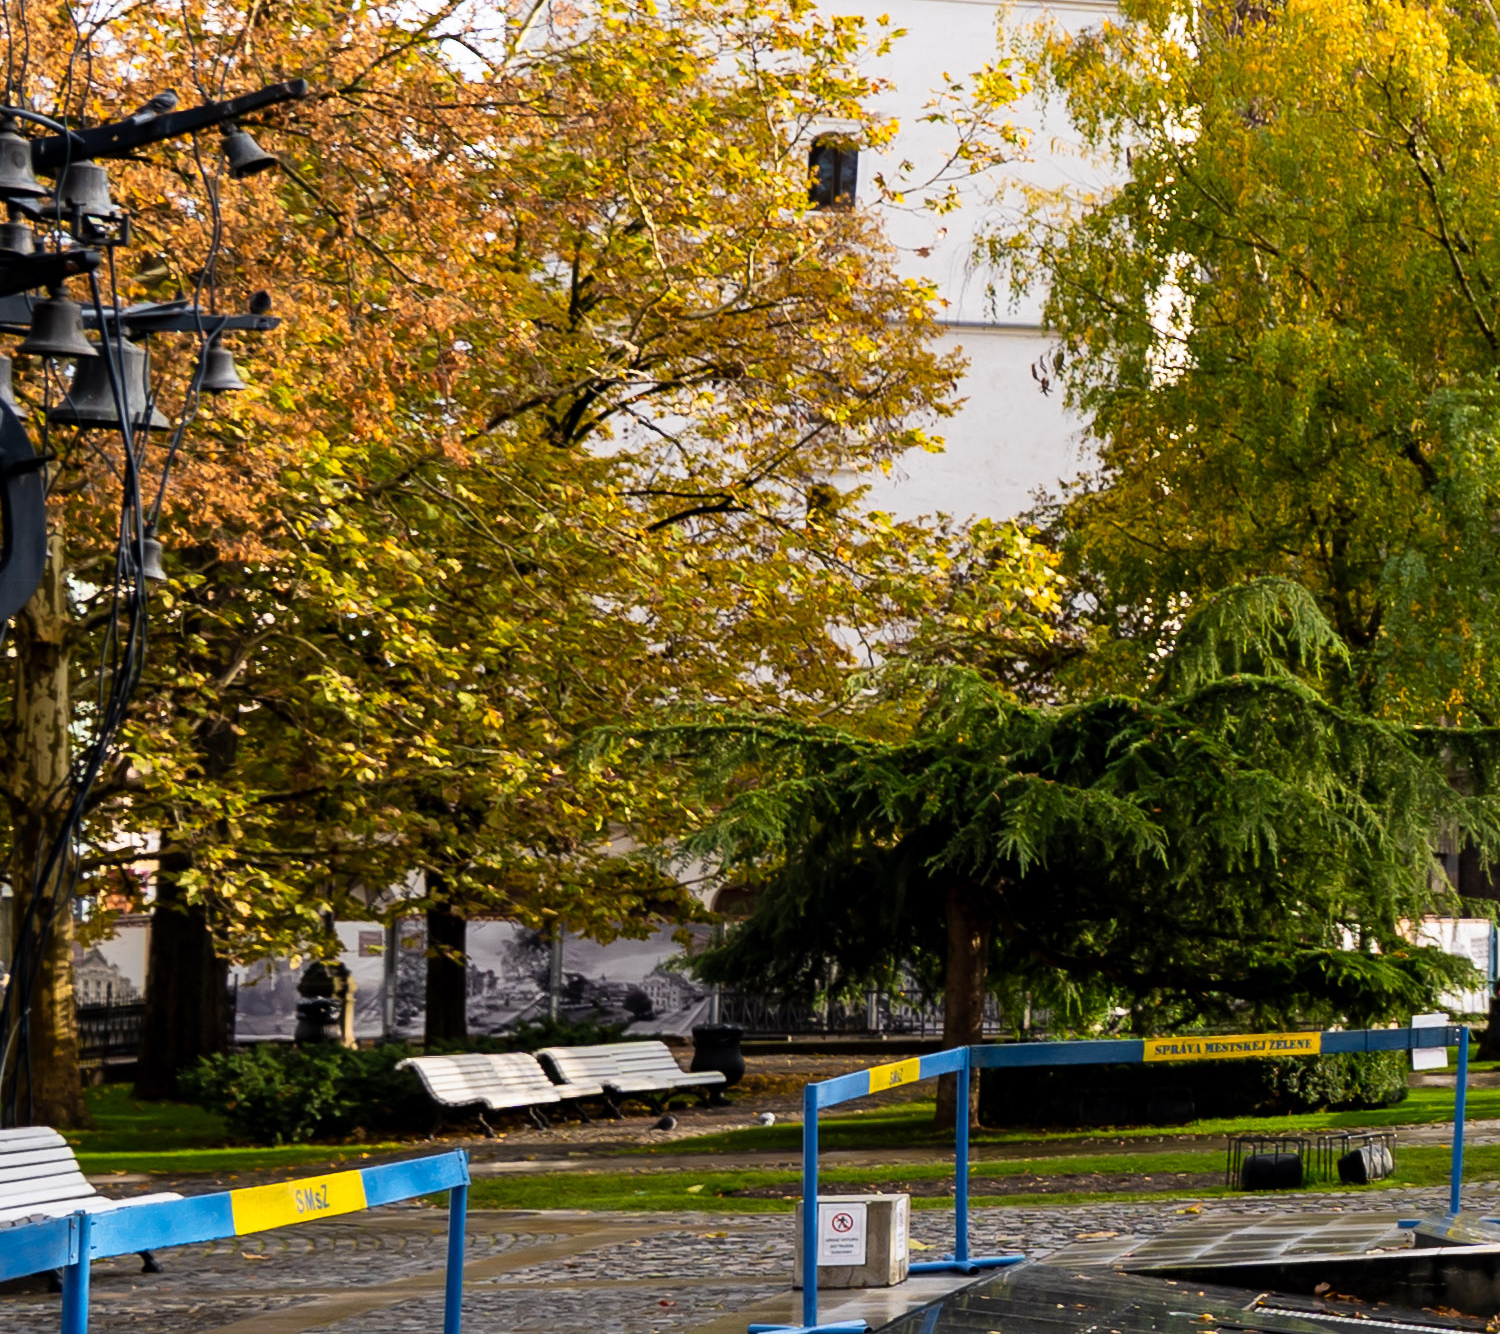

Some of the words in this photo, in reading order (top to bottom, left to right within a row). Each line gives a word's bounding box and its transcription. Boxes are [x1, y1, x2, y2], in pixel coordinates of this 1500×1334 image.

[1155, 1041, 1201, 1055] SPRÁVA
[1205, 1041, 1266, 1054] MESTSKEJ
[1269, 1038, 1313, 1050] ZELENE
